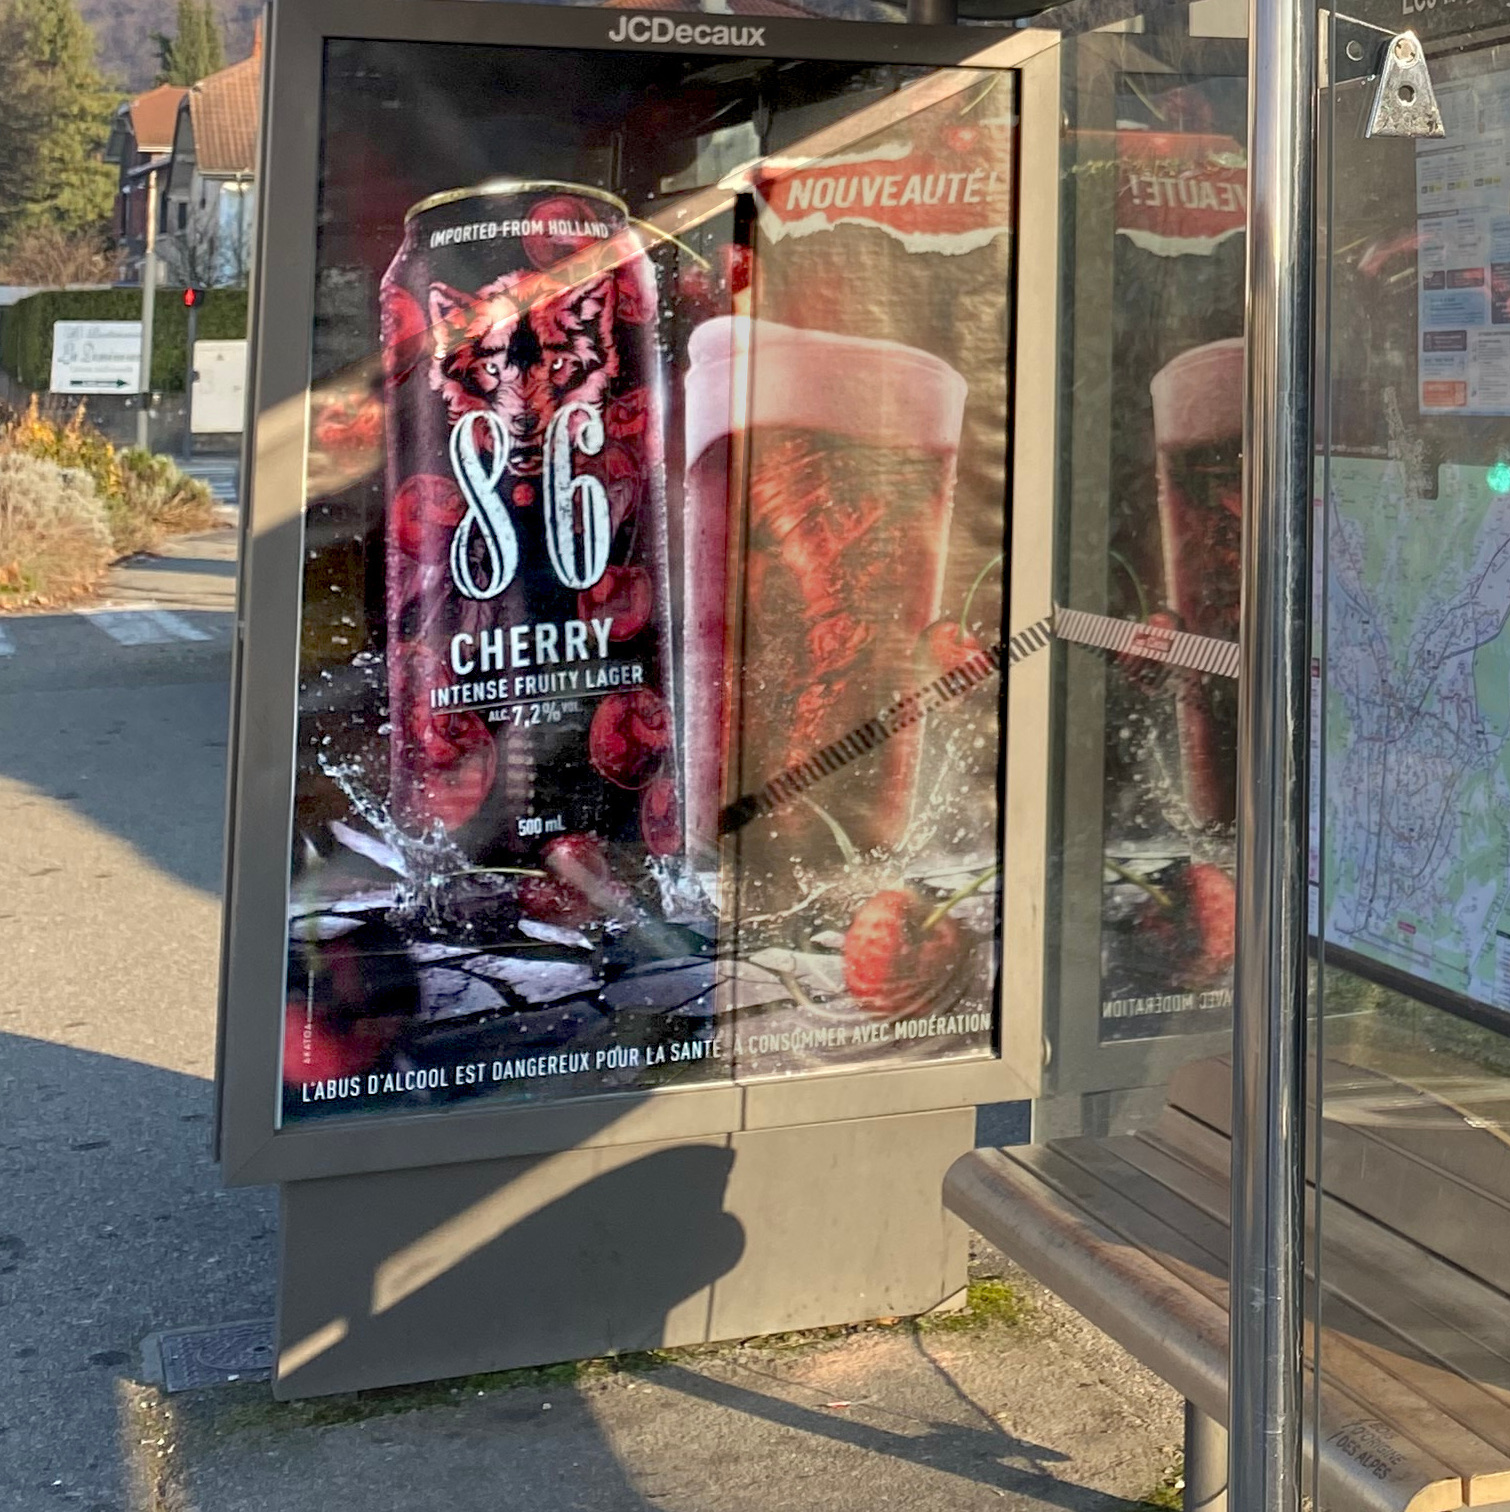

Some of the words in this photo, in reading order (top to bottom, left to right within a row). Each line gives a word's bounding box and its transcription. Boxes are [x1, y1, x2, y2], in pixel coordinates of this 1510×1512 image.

[608, 15, 767, 47] JCDecaux
[786, 167, 998, 211] NOUVEAUTÉ!
[430, 221, 497, 249] IMPORTED
[502, 219, 544, 237] FROM
[549, 219, 609, 239] HOLLAND
[450, 617, 614, 676] CHERRY
[430, 678, 509, 709] INTENSE
[514, 670, 581, 697] FRUITY
[585, 664, 644, 689] LAGER
[517, 816, 543, 837] 500
[301, 1075, 361, 1103] L'ABUS
[367, 1068, 449, 1095] D'ALCOOL
[455, 1062, 488, 1086] EST
[492, 1051, 590, 1082] DANGEREUX
[596, 1046, 640, 1071] POUR
[646, 1043, 665, 1066] LA
[749, 1025, 846, 1055] CONSOMMER
[850, 1020, 890, 1045] AVEC
